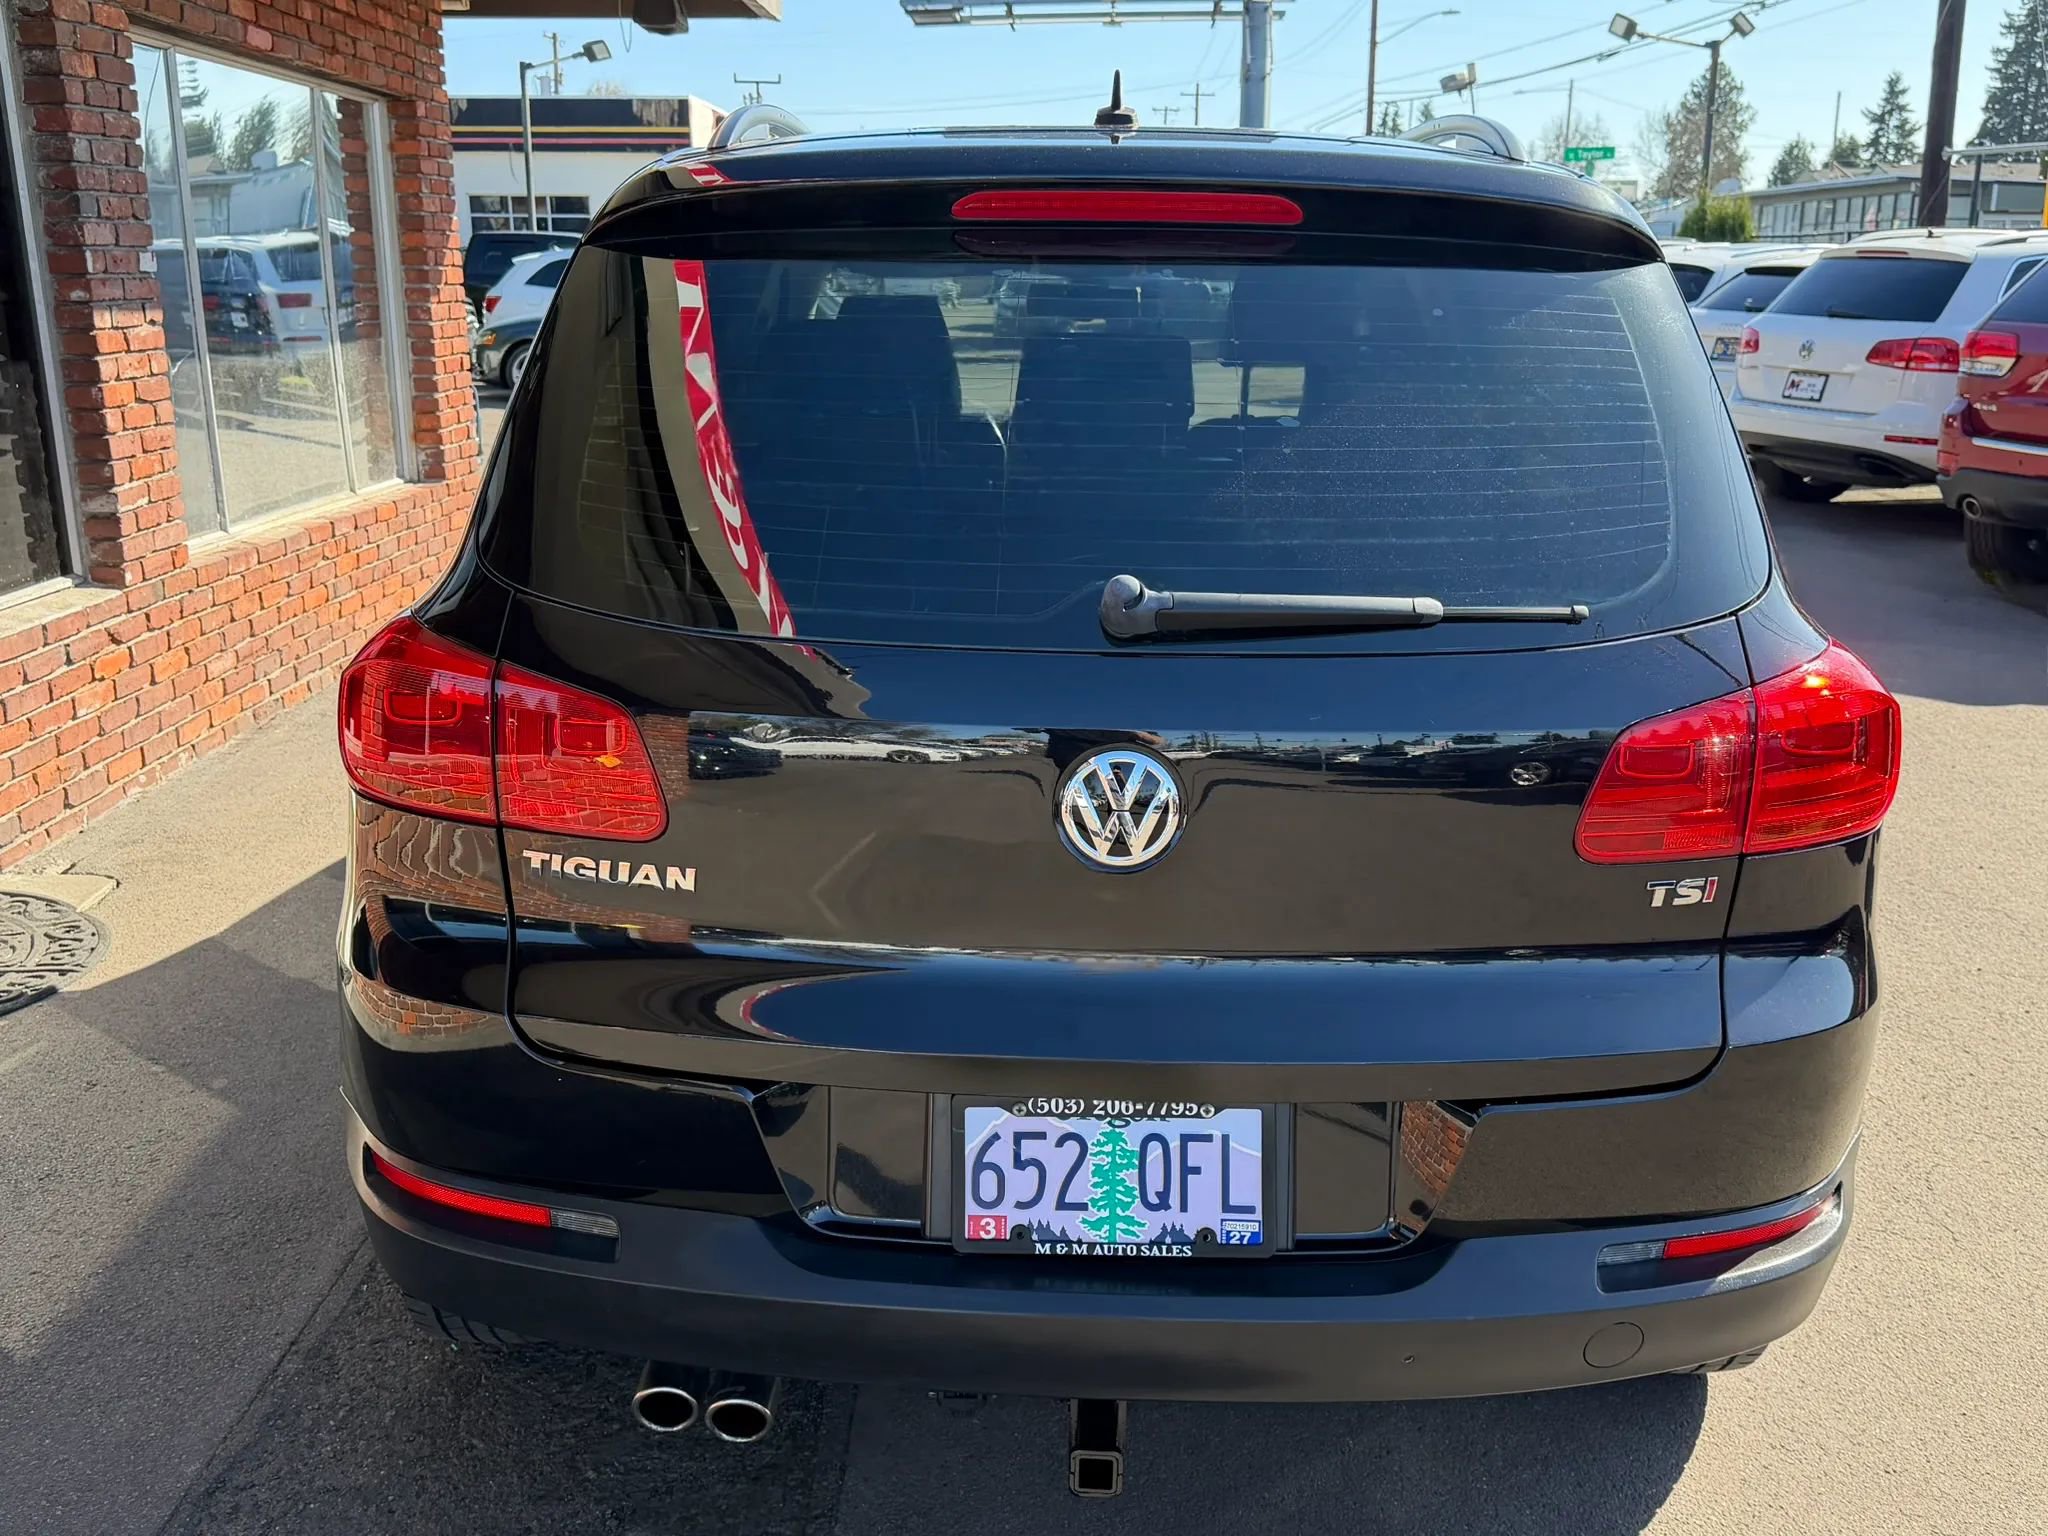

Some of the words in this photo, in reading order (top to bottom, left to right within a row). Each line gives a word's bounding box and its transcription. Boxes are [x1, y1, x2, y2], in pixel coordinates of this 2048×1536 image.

[1061, 751, 1180, 867] VW
[523, 849, 697, 893] TIGUAN
[1647, 877, 1719, 907] TSI
[1027, 1097, 1086, 1115] (503)
[971, 1131, 1089, 1211] 652
[1138, 1132, 1257, 1215] QFL
[979, 1217, 996, 1240] 3
[1229, 1231, 1252, 1245] 27
[1035, 1243, 1051, 1255] M
[1056, 1243, 1068, 1255] &
[1072, 1244, 1089, 1256] M
[1093, 1244, 1137, 1256] AUTO
[1141, 1245, 1192, 1257] SALES
